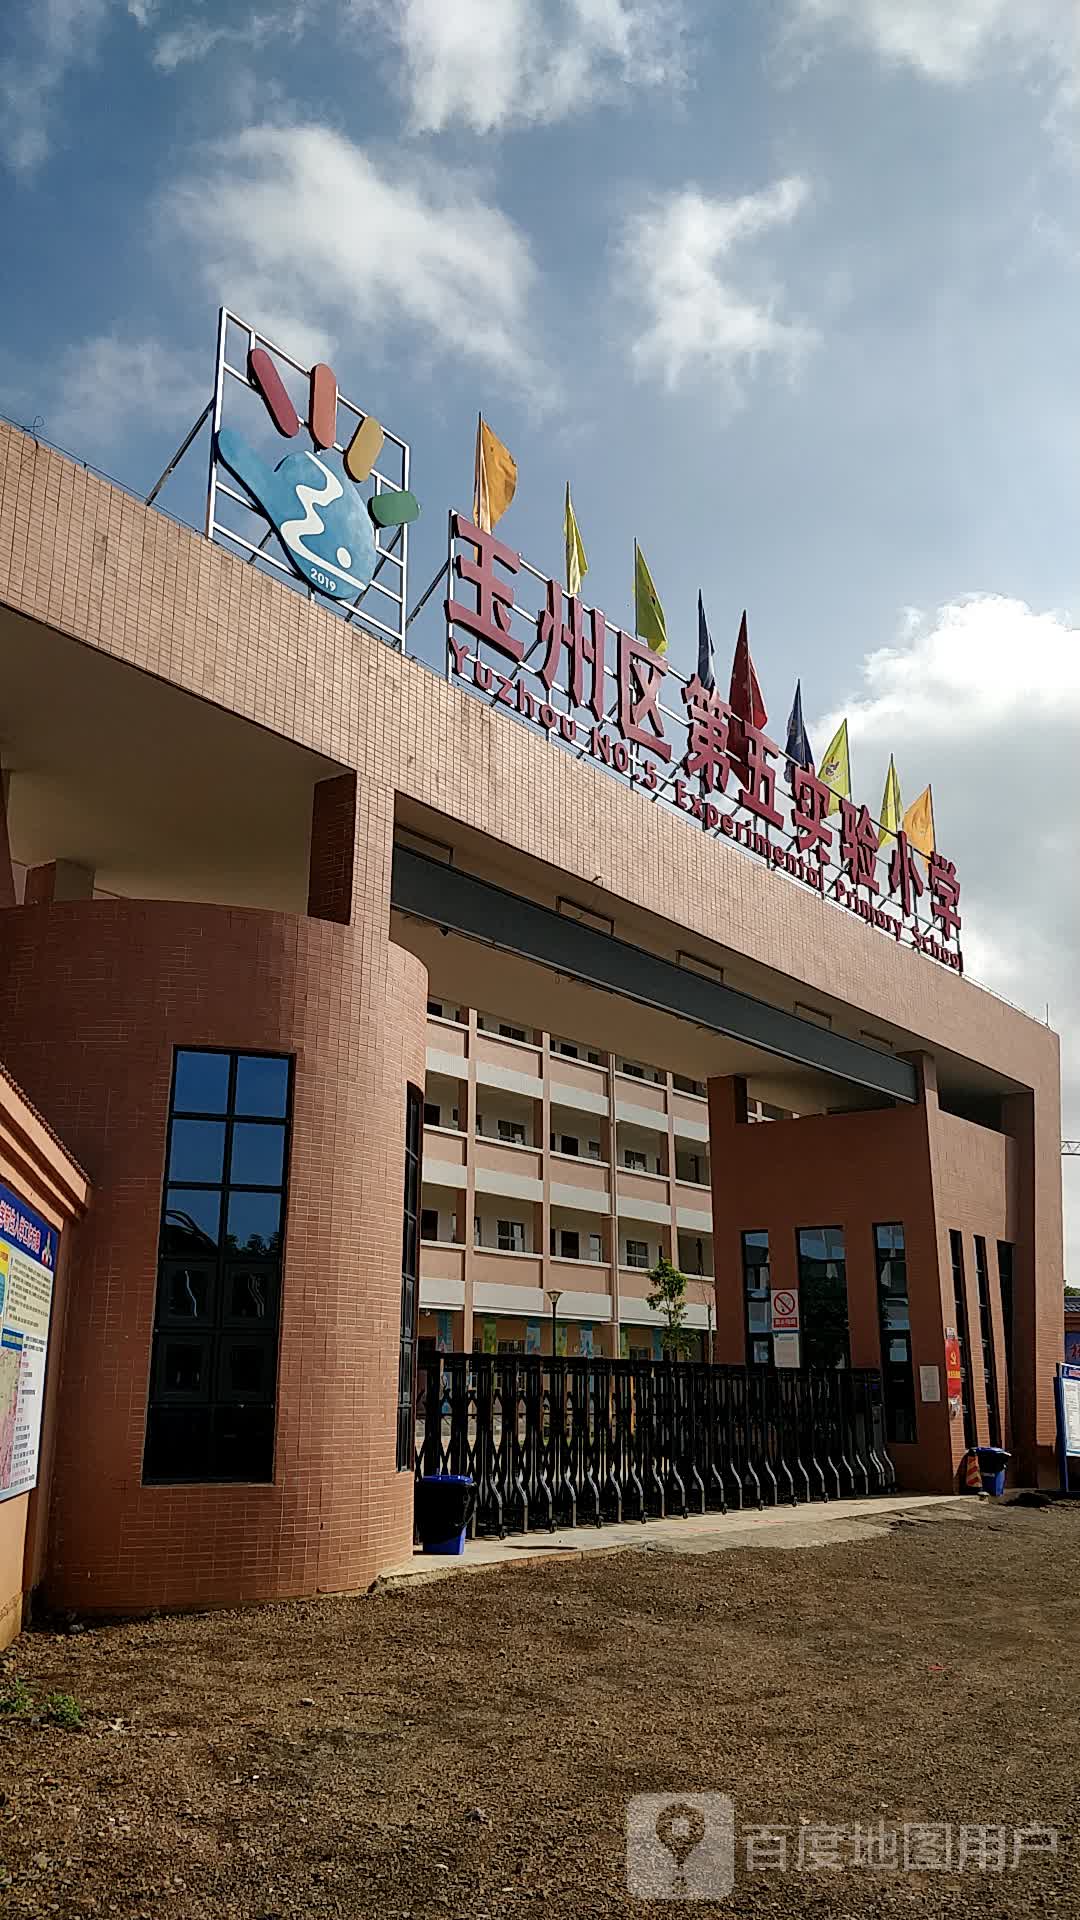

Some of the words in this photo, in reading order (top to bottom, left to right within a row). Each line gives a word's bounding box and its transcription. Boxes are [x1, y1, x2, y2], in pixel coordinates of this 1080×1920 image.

[310, 567, 337, 592] 2019
[445, 514, 962, 941] 玉州区第五实验小学
[448, 637, 577, 741] Yuzhou
[674, 779, 824, 892] Experimental
[835, 881, 904, 941] Primary
[912, 927, 963, 972] School
